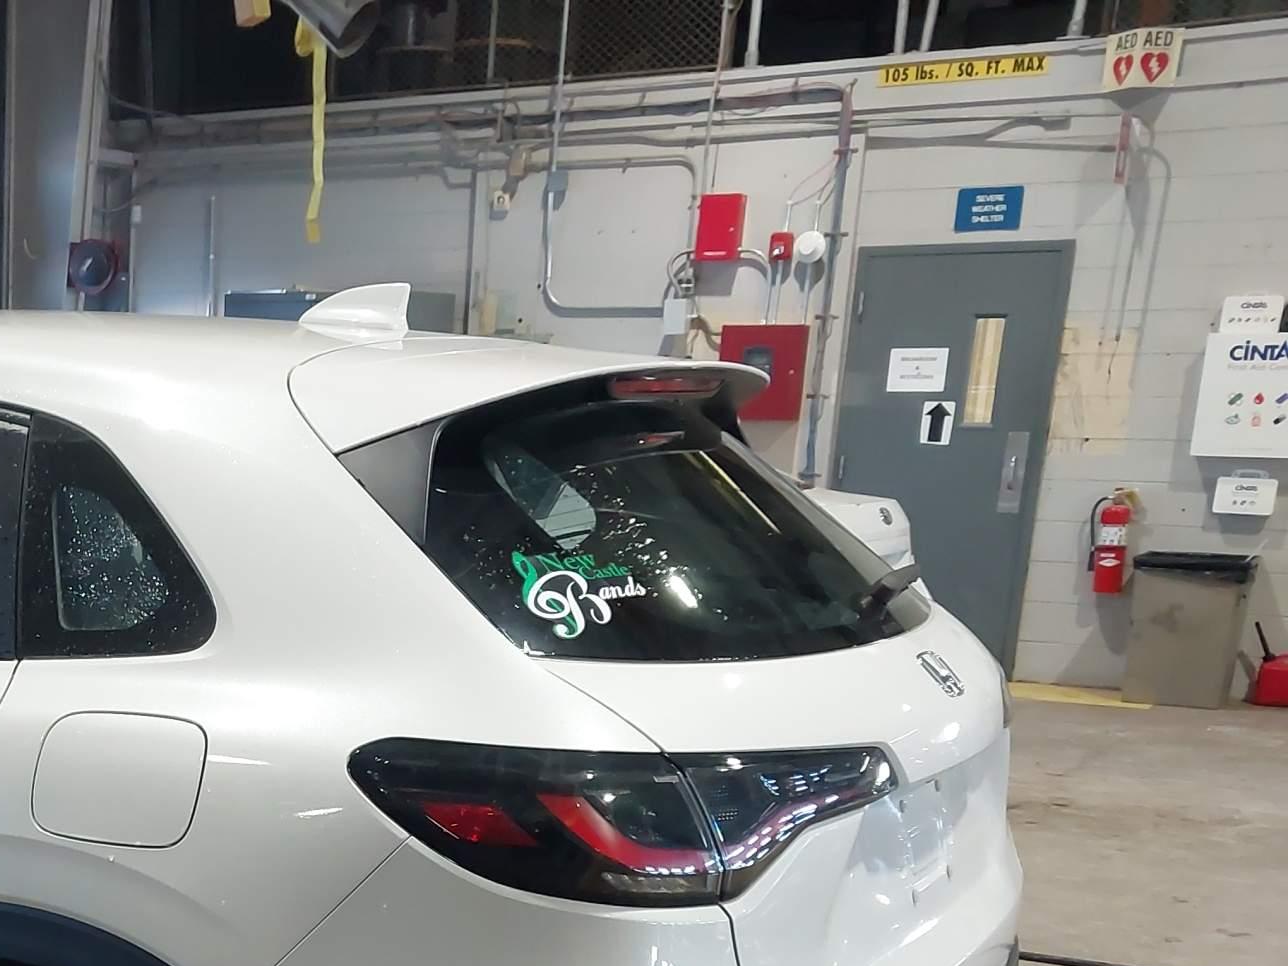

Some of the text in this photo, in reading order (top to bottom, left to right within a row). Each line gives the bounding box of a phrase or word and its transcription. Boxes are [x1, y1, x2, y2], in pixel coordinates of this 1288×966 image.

[1115, 32, 1138, 51] AED
[1143, 30, 1174, 47] AED
[885, 56, 1046, 83] 105 lbs. / SQ. FT. MAX
[535, 552, 596, 572] New
[579, 563, 629, 580] Castle
[527, 570, 648, 639] Bands
